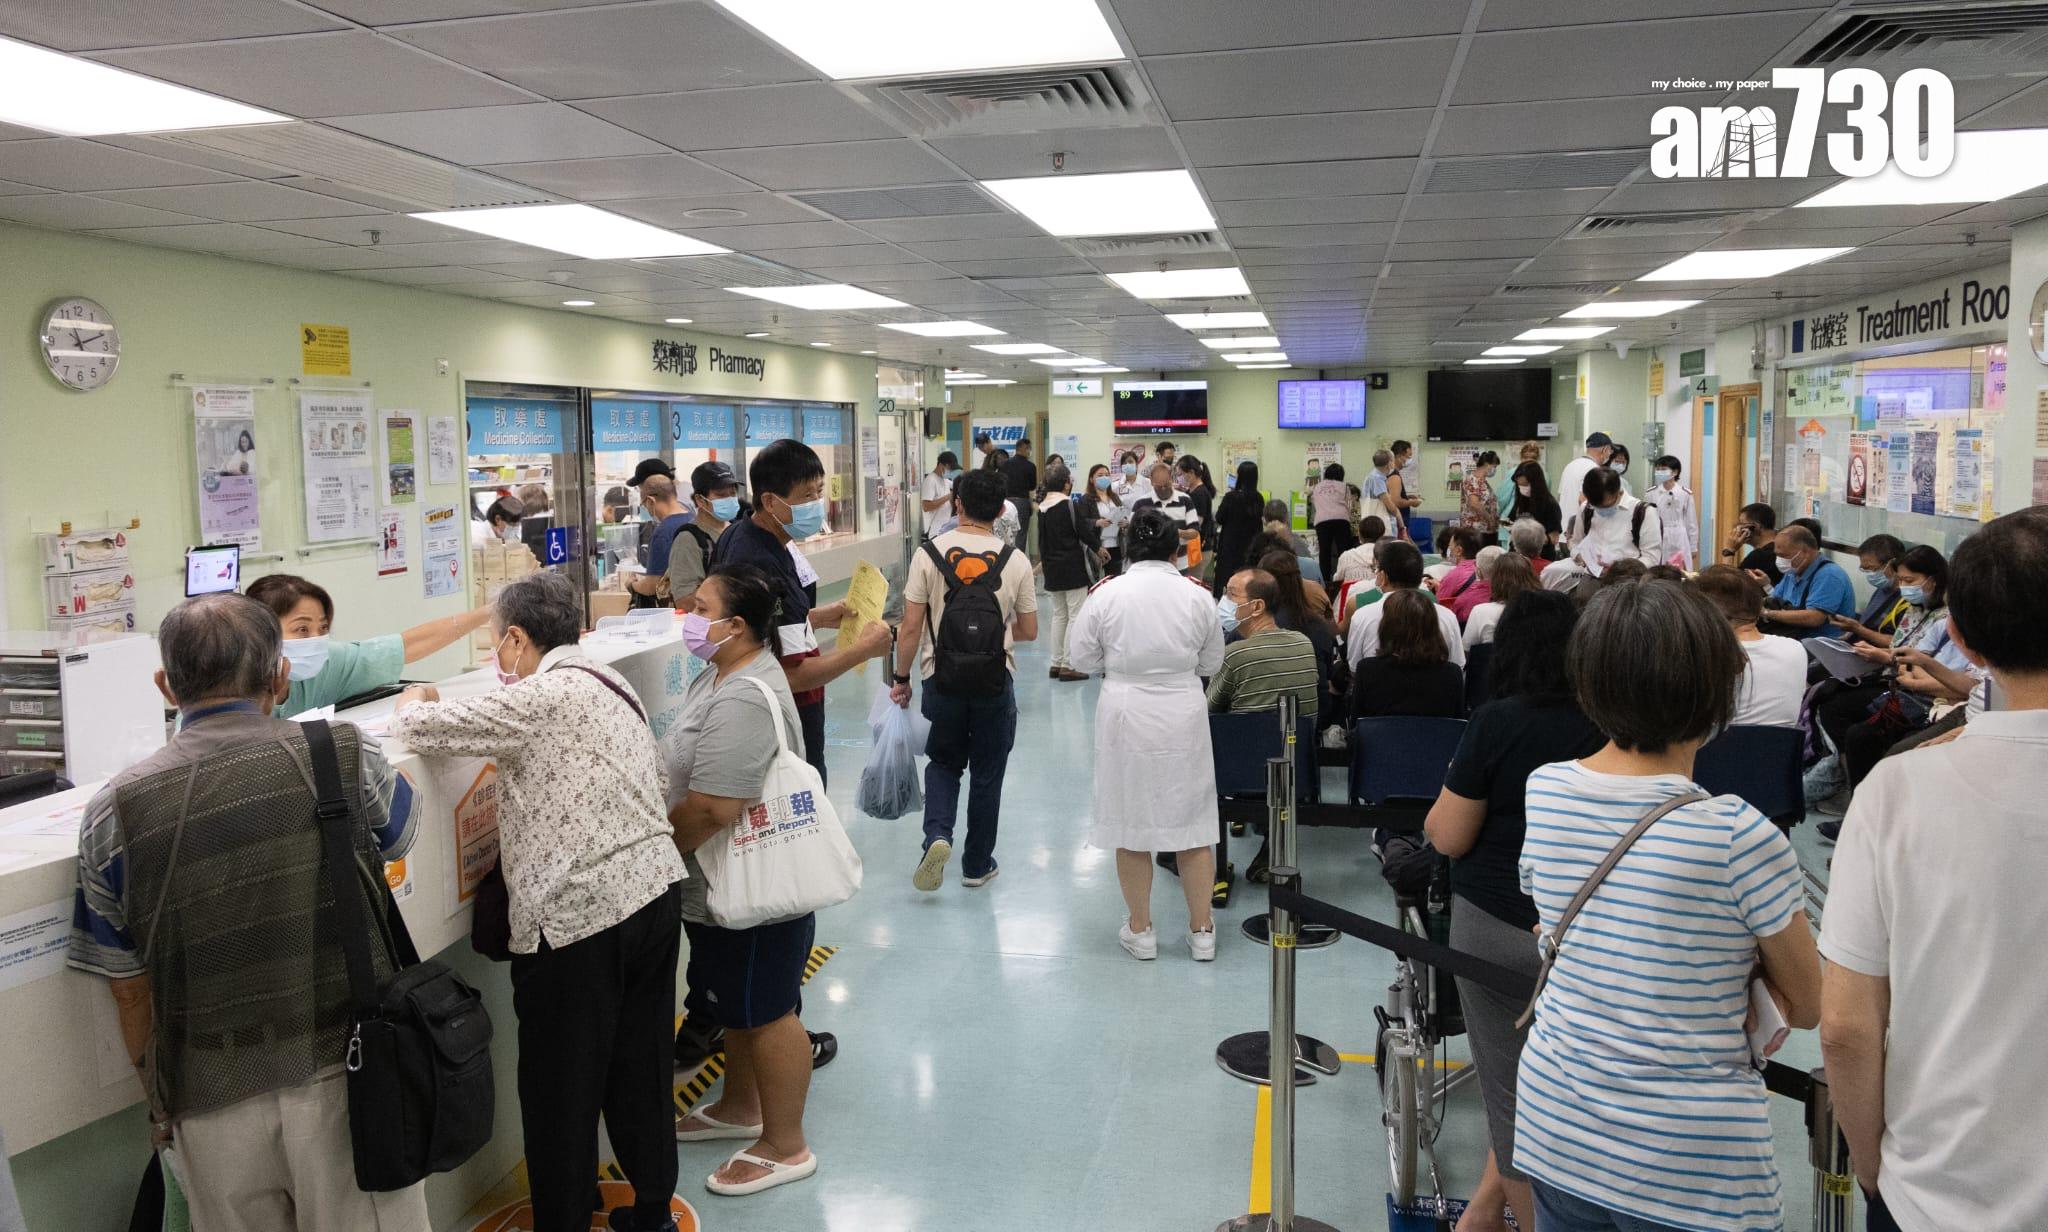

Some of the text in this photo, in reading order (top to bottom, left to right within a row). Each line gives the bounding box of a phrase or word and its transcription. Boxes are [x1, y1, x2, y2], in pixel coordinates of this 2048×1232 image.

[60, 309, 70, 320] 11
[73, 306, 83, 317] 12
[1810, 312, 1849, 350] 治療室
[1857, 288, 1951, 343] Treatment
[48, 335, 55, 347] 9
[102, 342, 109, 352] 3
[652, 339, 765, 381] 藥劑部 Pharmacy
[63, 366, 70, 377] 7
[77, 371, 84, 382] 6
[90, 367, 97, 378] 5
[1696, 378, 1708, 394] 4
[1119, 390, 1154, 399] 89 94
[878, 399, 895, 413] 20
[494, 406, 548, 429] 取藥處
[610, 408, 650, 428] 取藥處
[672, 411, 681, 441] 3
[484, 431, 555, 446] Medicine Collection
[602, 430, 630, 443] Medicine
[126, 612, 135, 629] S
[734, 815, 816, 847] Spot and Report
